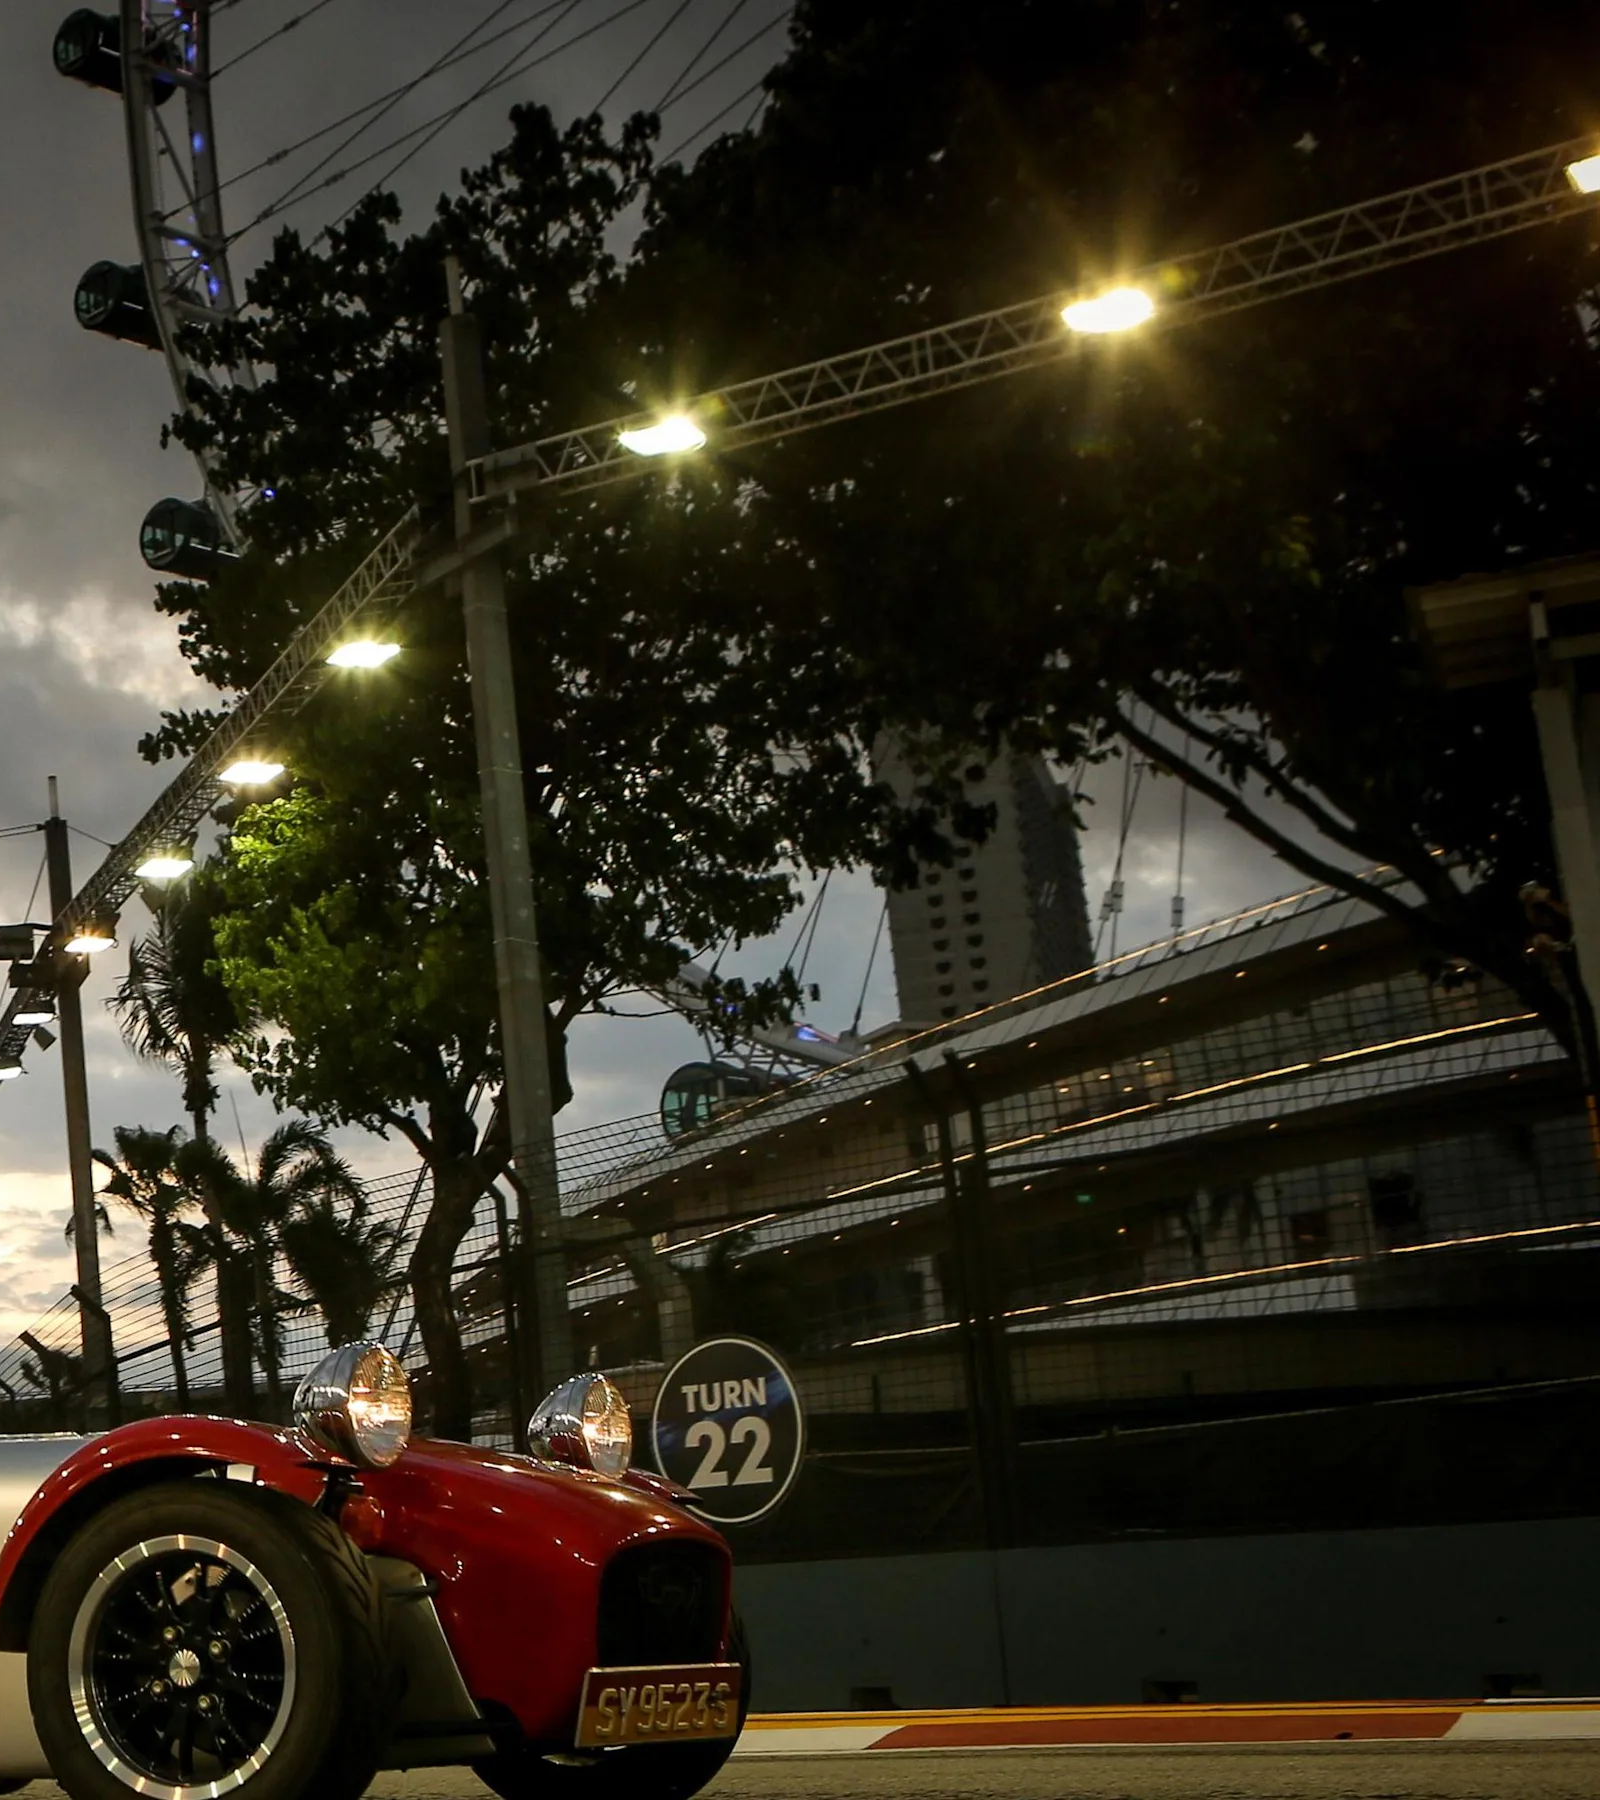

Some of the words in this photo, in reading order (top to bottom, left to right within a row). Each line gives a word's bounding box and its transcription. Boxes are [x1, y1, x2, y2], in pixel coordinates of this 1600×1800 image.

[681, 1377, 767, 1414] TURN
[685, 1416, 773, 1489] 22
[595, 1682, 731, 1737] SY9523S
